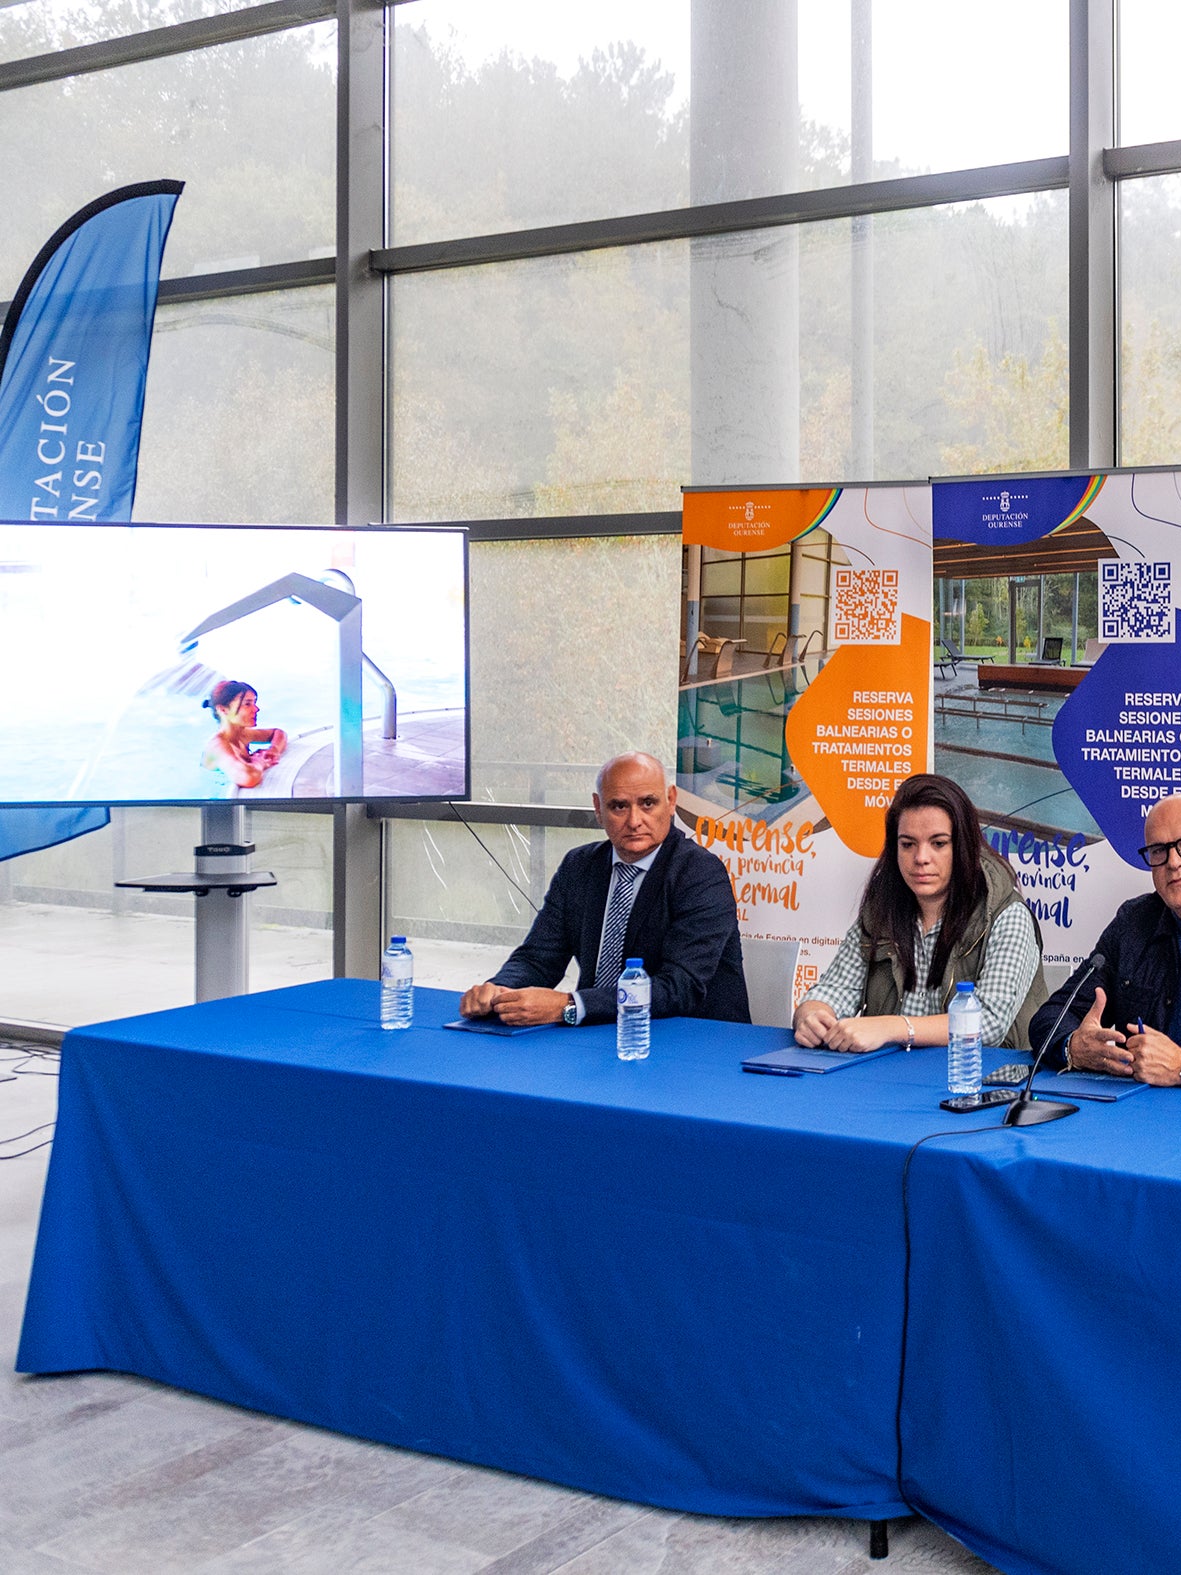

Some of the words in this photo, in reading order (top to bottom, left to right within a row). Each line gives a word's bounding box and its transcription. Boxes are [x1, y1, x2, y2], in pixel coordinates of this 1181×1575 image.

[982, 511, 1029, 522] DEPUTACIÓN
[728, 521, 771, 530] DEPUTACIÓN
[988, 520, 1023, 529] OURENSE
[733, 529, 765, 537] OURENSE
[853, 691, 914, 704] RESERVA
[847, 708, 913, 721] SESIONES
[816, 725, 898, 738] BALNEARIAS
[901, 727, 913, 739] O
[1086, 729, 1175, 743] BALNEARIAS
[812, 742, 912, 756] TRATAMIENTOS
[841, 760, 912, 774] TERMALES
[847, 777, 890, 790] DESDE
[1121, 786, 1168, 799] DESDE
[695, 815, 817, 858] Ourense,
[738, 854, 804, 877] provincia
[731, 872, 800, 911] termal
[1041, 954, 1070, 963] spaña
